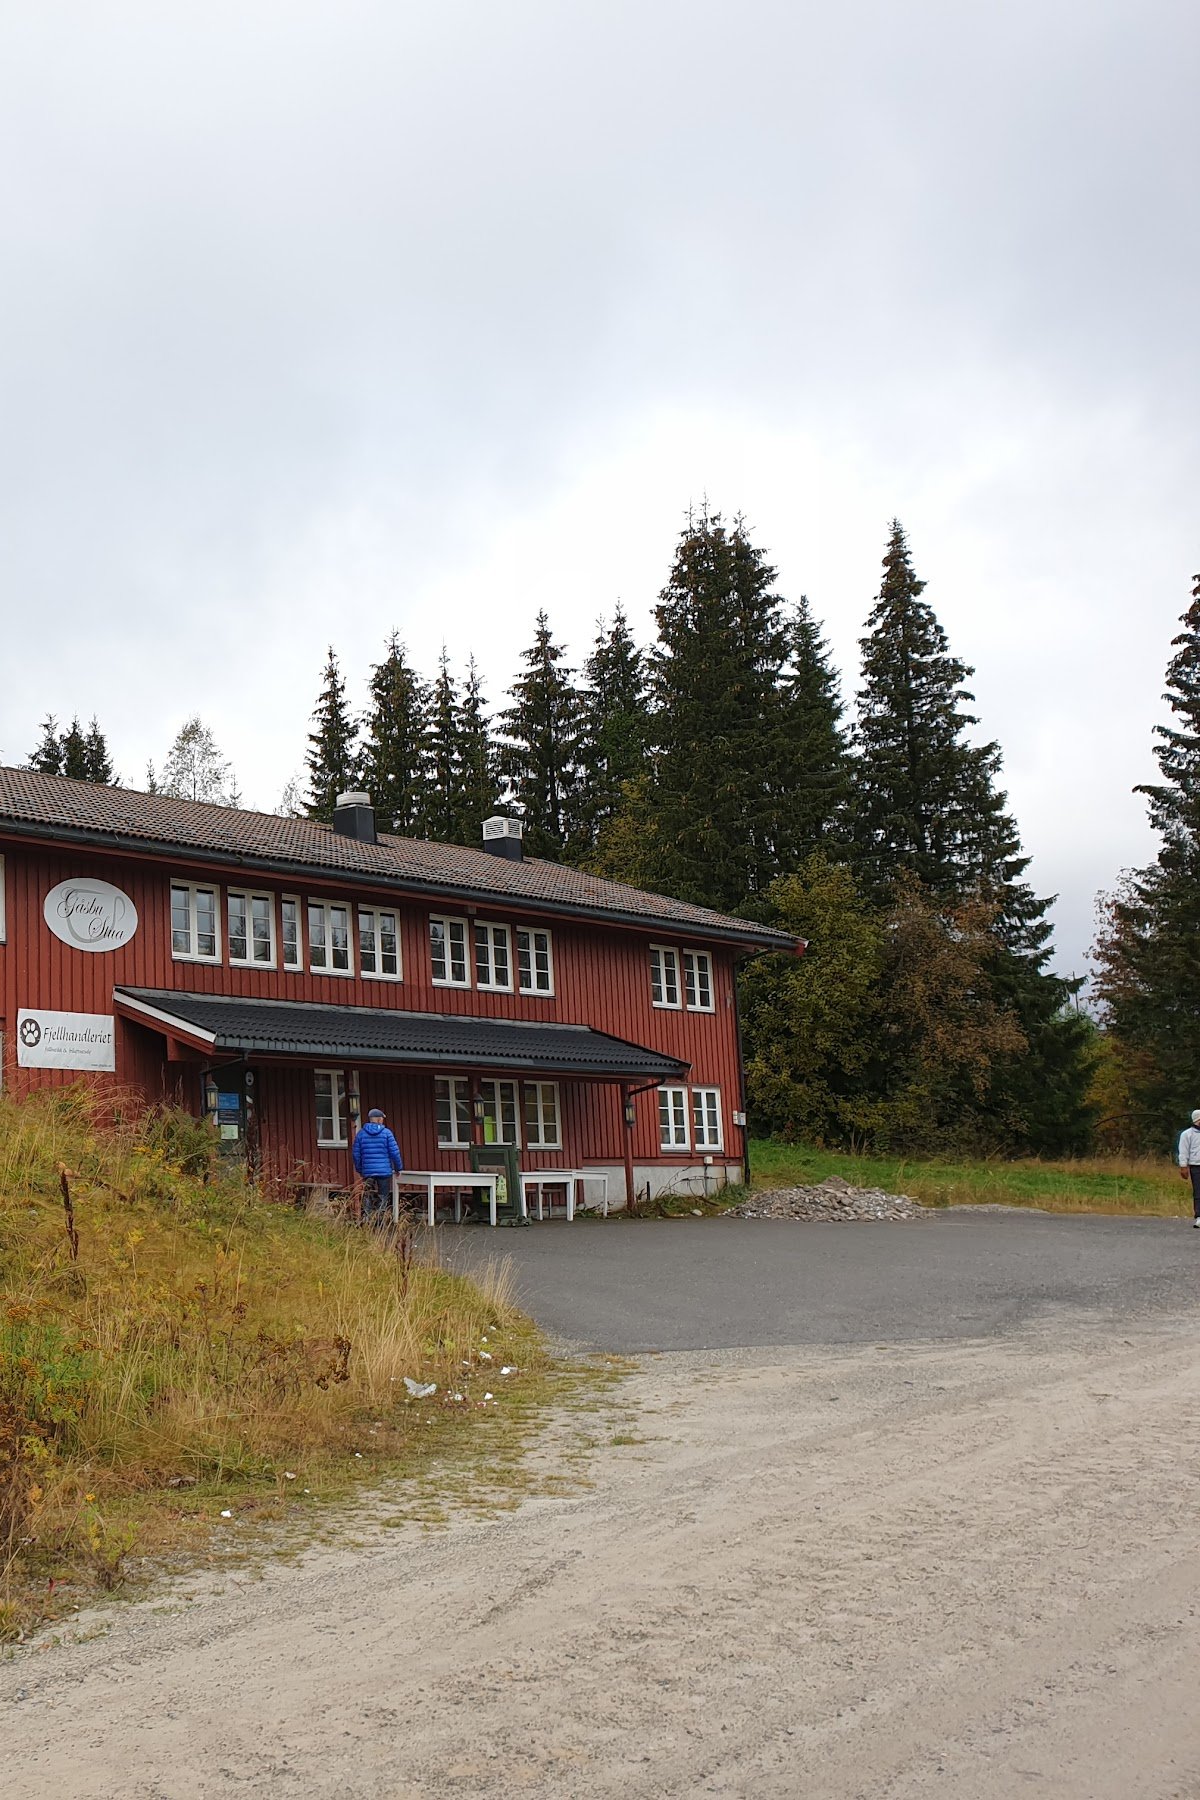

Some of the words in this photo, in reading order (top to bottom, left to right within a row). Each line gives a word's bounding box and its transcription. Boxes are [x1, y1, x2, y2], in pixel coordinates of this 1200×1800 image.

[57, 887, 103, 918] Gåsbu
[89, 917, 124, 940] Stua
[43, 1026, 112, 1043] Fjellhandleriet
